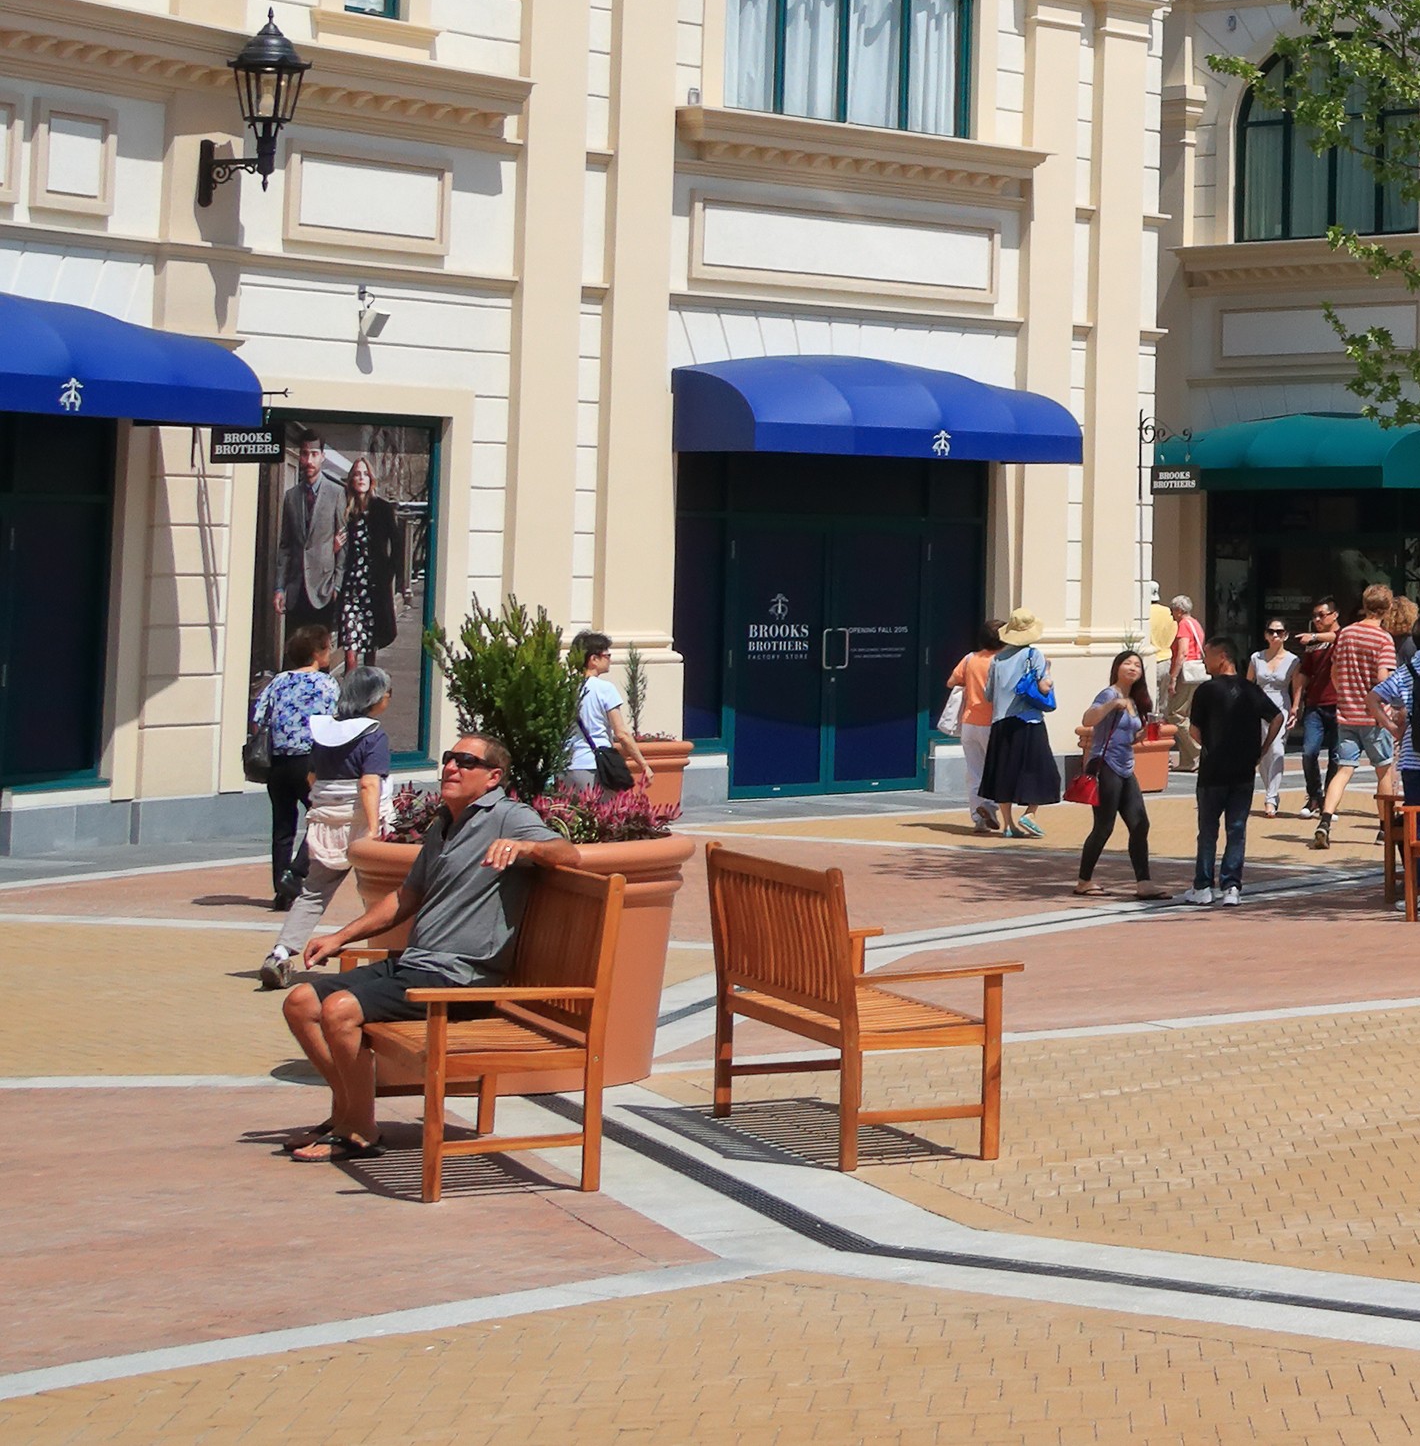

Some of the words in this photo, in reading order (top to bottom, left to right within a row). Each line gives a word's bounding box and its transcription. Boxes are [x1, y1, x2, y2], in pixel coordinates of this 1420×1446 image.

[223, 432, 272, 443] BROOKS
[215, 444, 280, 454] BROTHERS
[1158, 471, 1191, 480] BROOKS
[1153, 480, 1196, 489] BROTHERS
[748, 624, 809, 638] BROOKS
[748, 641, 809, 651] BROTHERS
